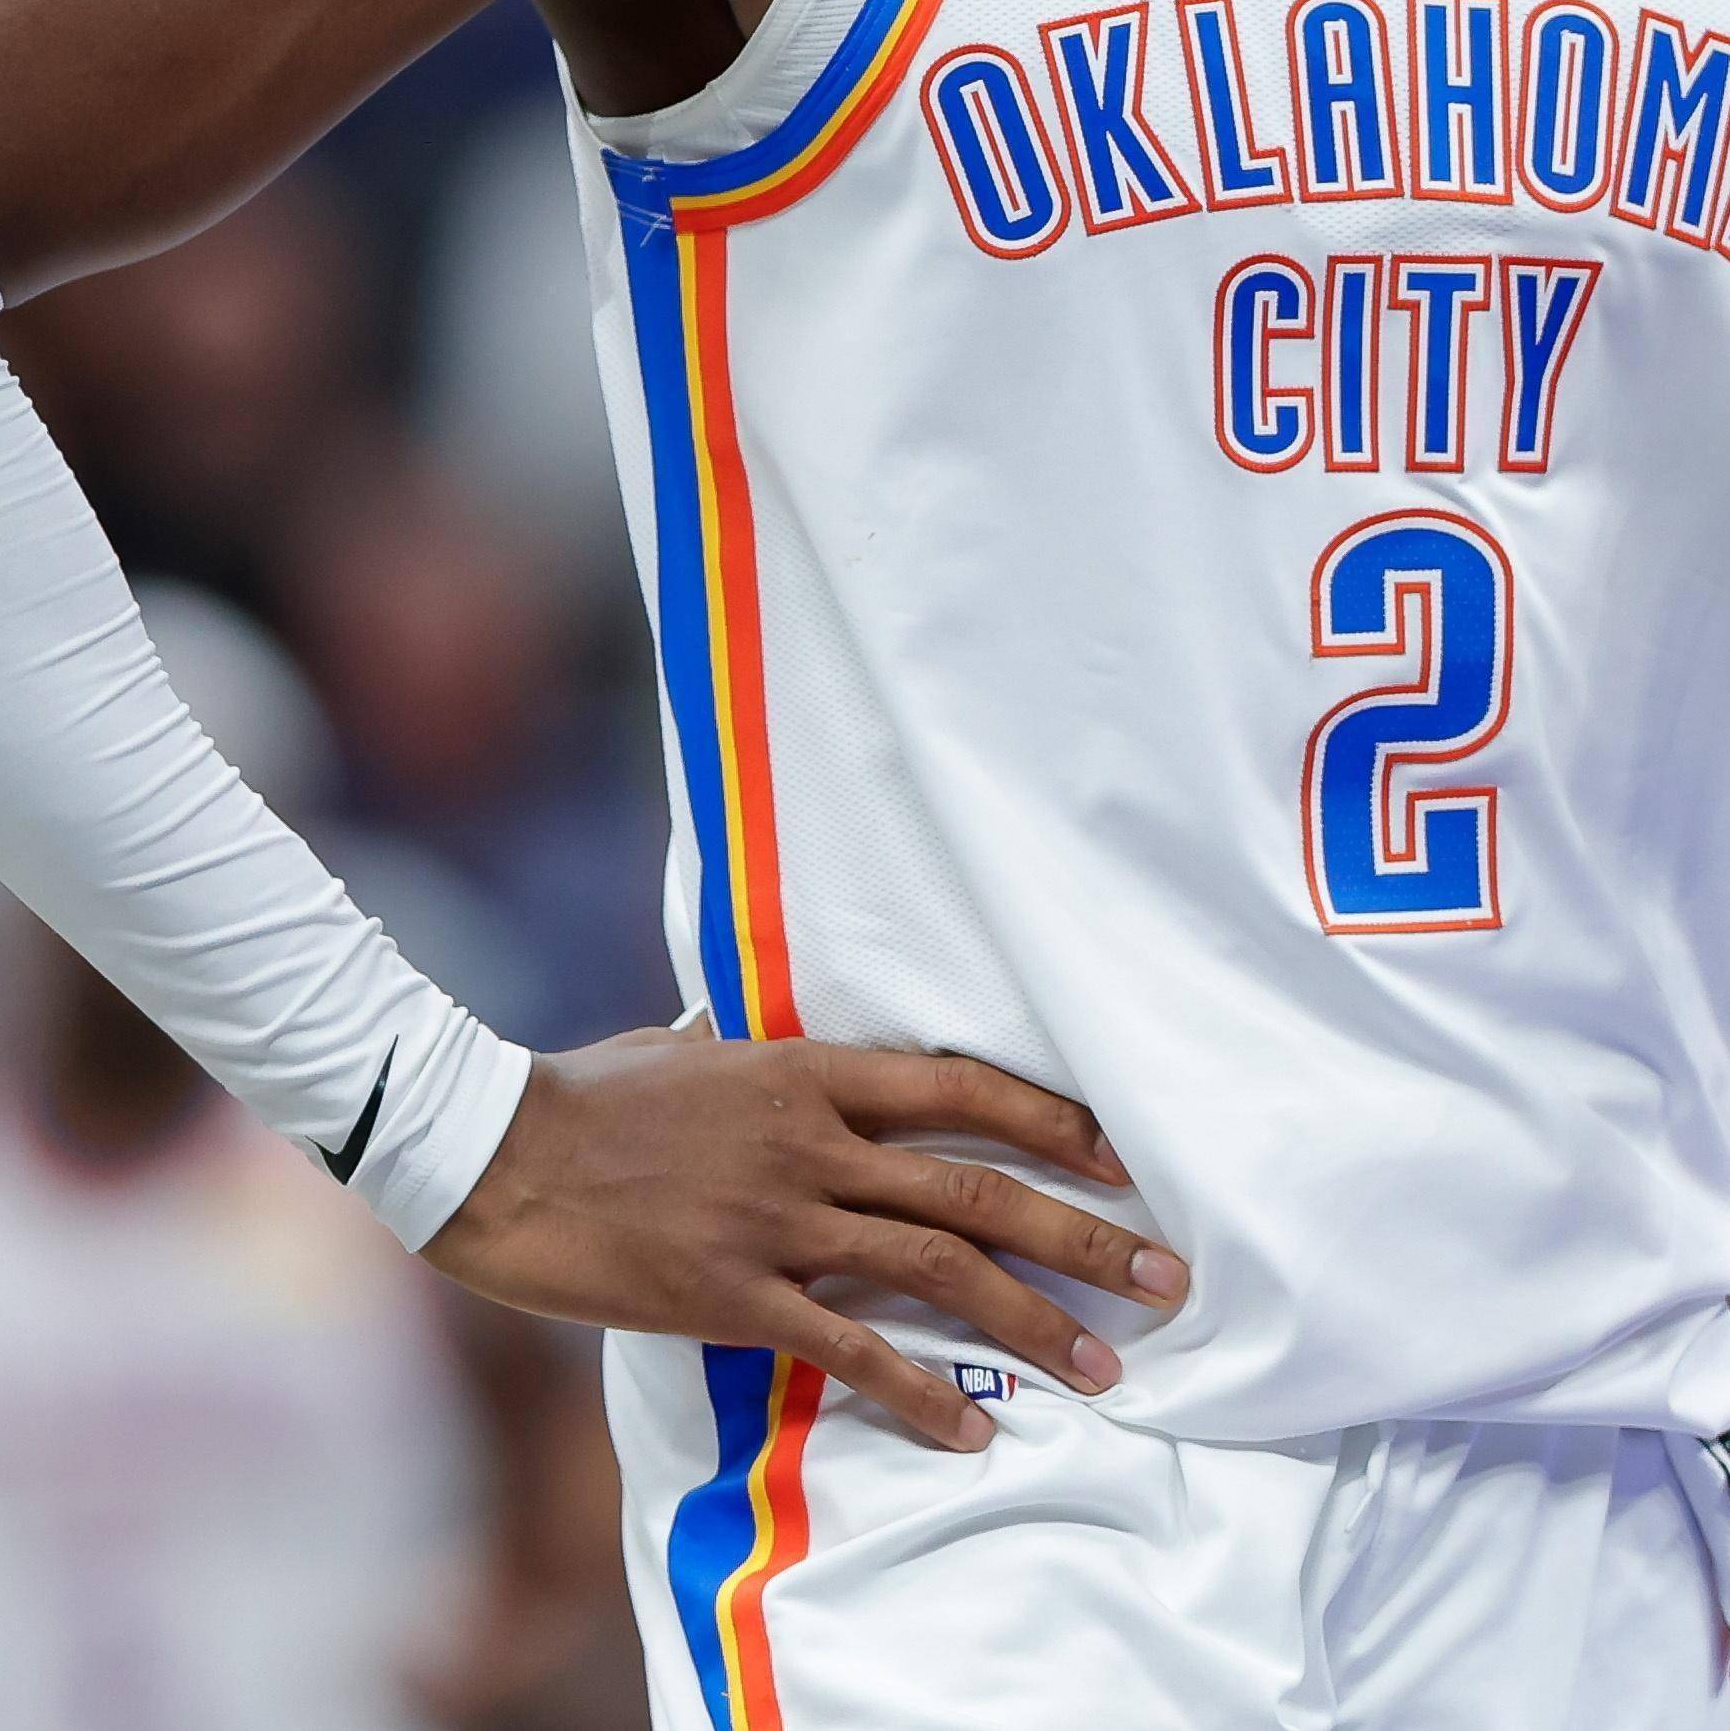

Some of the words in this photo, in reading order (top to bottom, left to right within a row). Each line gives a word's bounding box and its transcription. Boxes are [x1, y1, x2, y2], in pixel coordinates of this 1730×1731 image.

[1213, 253, 1603, 473] CITY
[1301, 507, 1513, 935] 2
[961, 1367, 996, 1393] NBA
